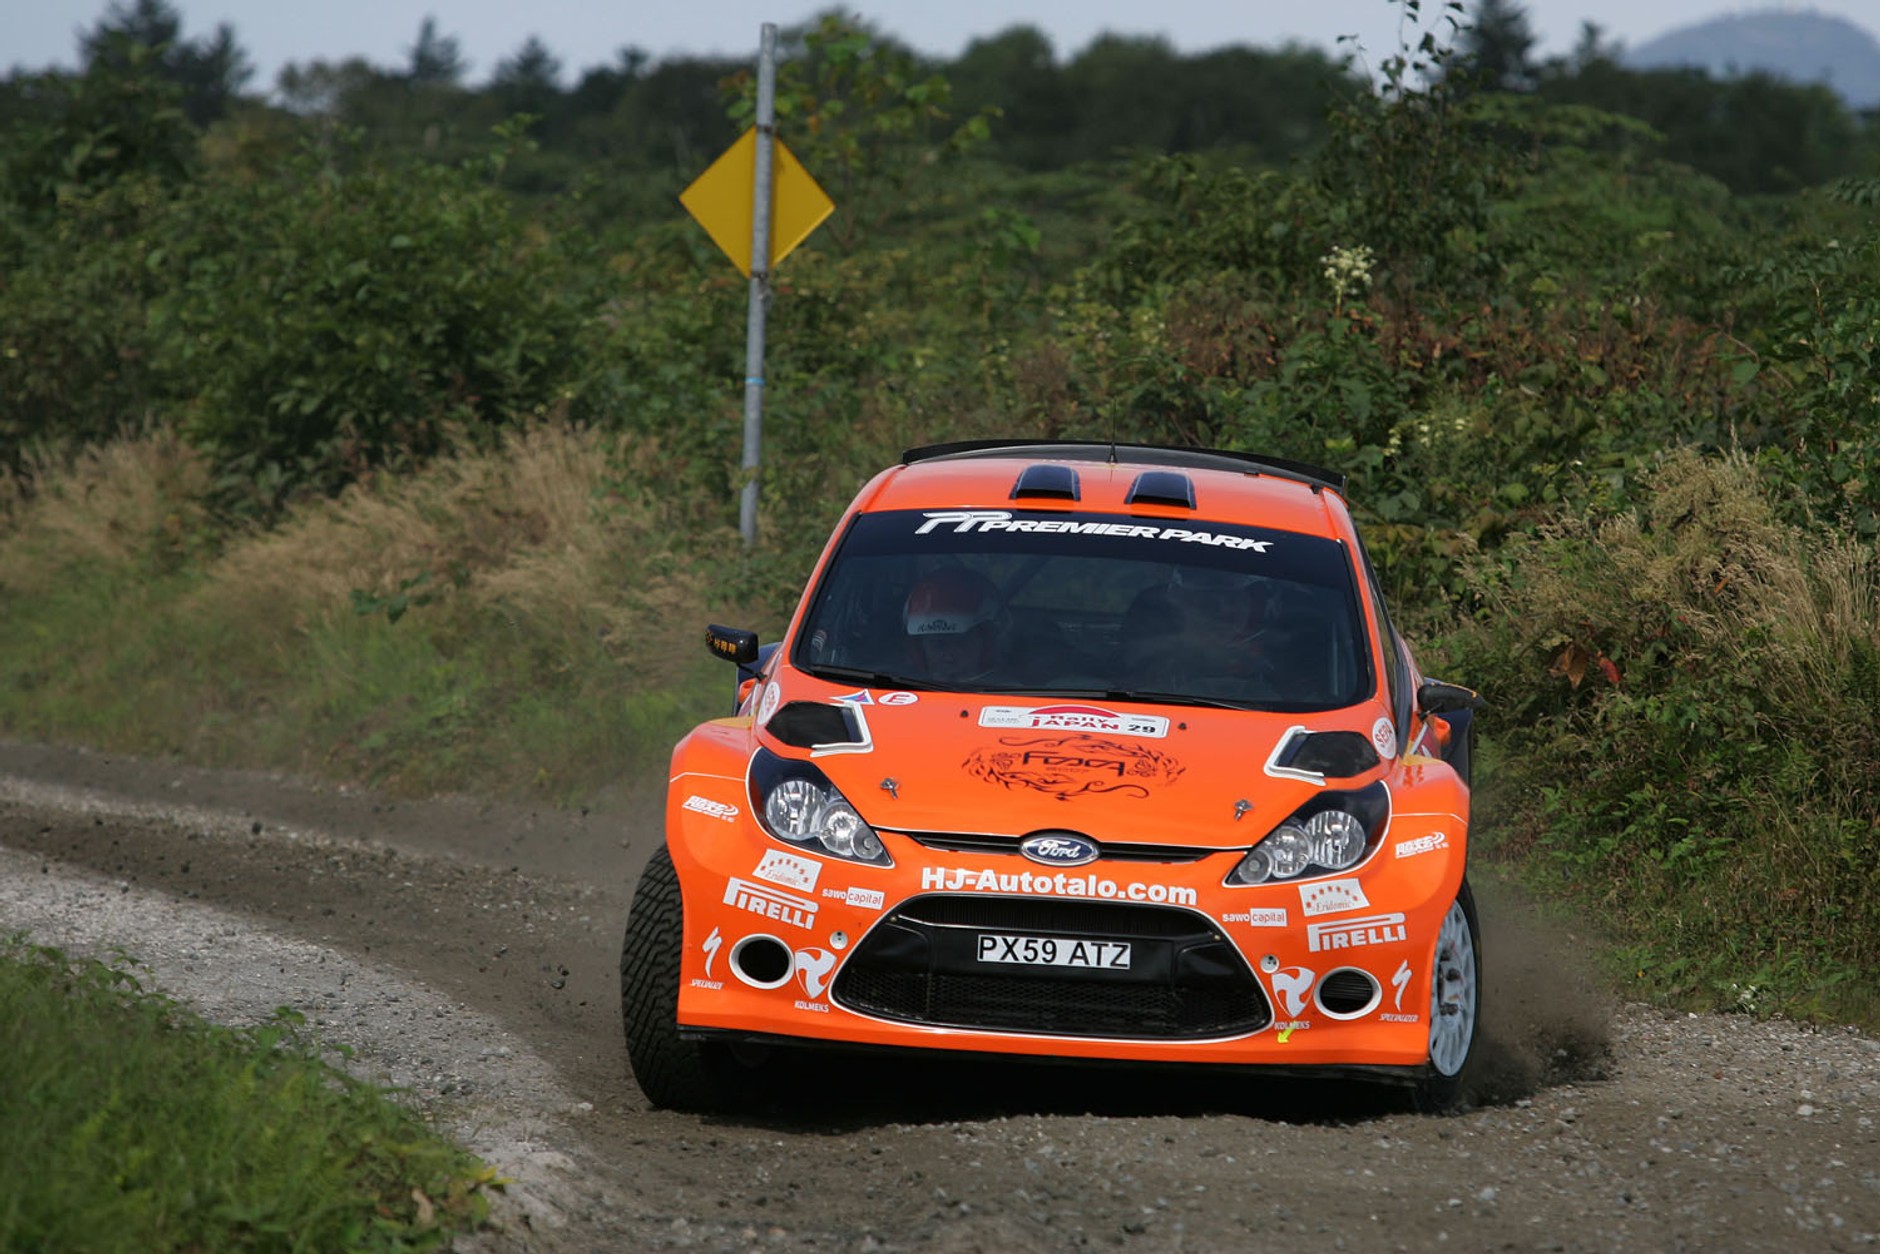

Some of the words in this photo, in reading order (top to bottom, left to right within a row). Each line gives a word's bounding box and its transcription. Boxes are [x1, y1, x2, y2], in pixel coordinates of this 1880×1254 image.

[978, 519, 1161, 539] PREMIER
[1158, 528, 1274, 553] PARK
[1128, 724, 1156, 733] 29
[1037, 839, 1080, 859] Ford
[921, 867, 1198, 905] HJ-Autotalo.com
[723, 877, 819, 930] PIRELLI
[1307, 912, 1407, 952] PIRELLI
[978, 936, 1058, 964] PX59
[1068, 941, 1129, 968] ATZ
